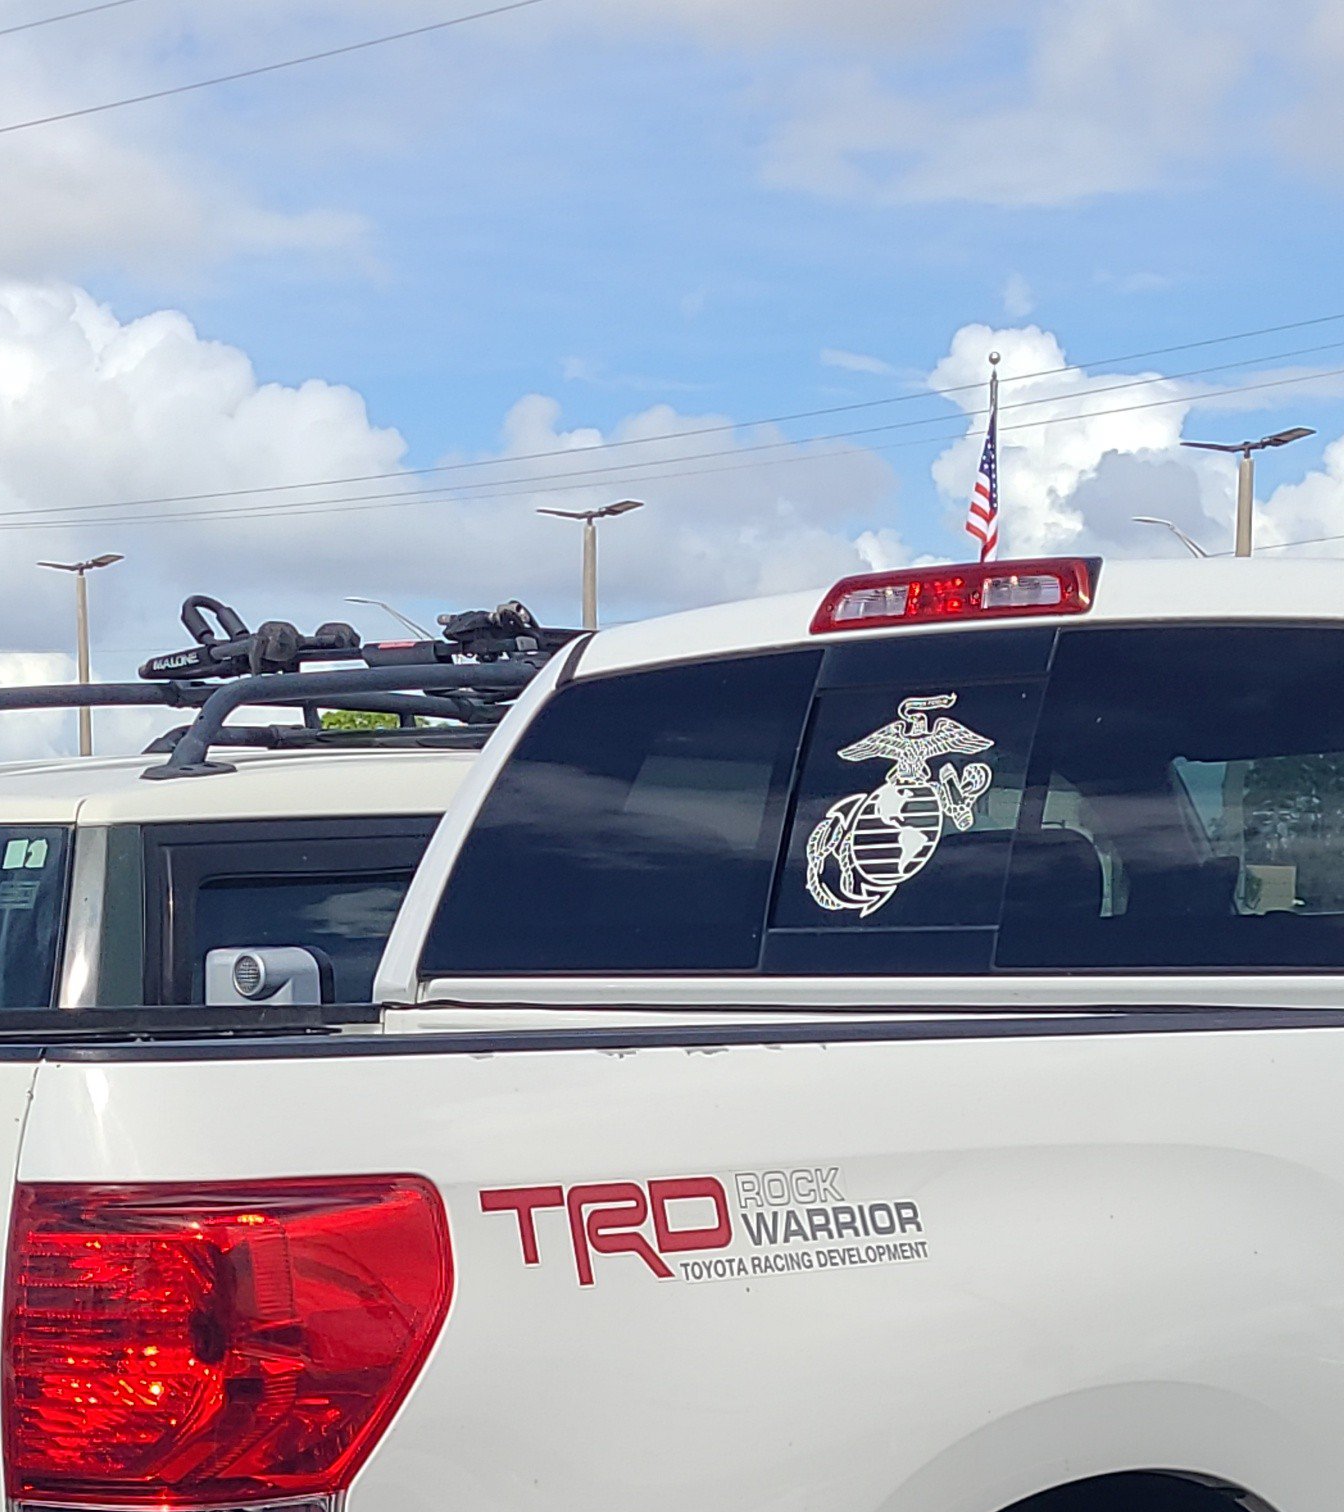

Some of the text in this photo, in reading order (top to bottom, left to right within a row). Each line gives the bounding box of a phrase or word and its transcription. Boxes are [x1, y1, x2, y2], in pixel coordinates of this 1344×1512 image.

[153, 652, 199, 670] MALONE
[734, 1167, 846, 1210] ROCK
[480, 1176, 733, 1286] TRD
[741, 1201, 923, 1246] WARRIOR
[680, 1241, 929, 1281] TOYOTA RACING DEVELOPMENT
